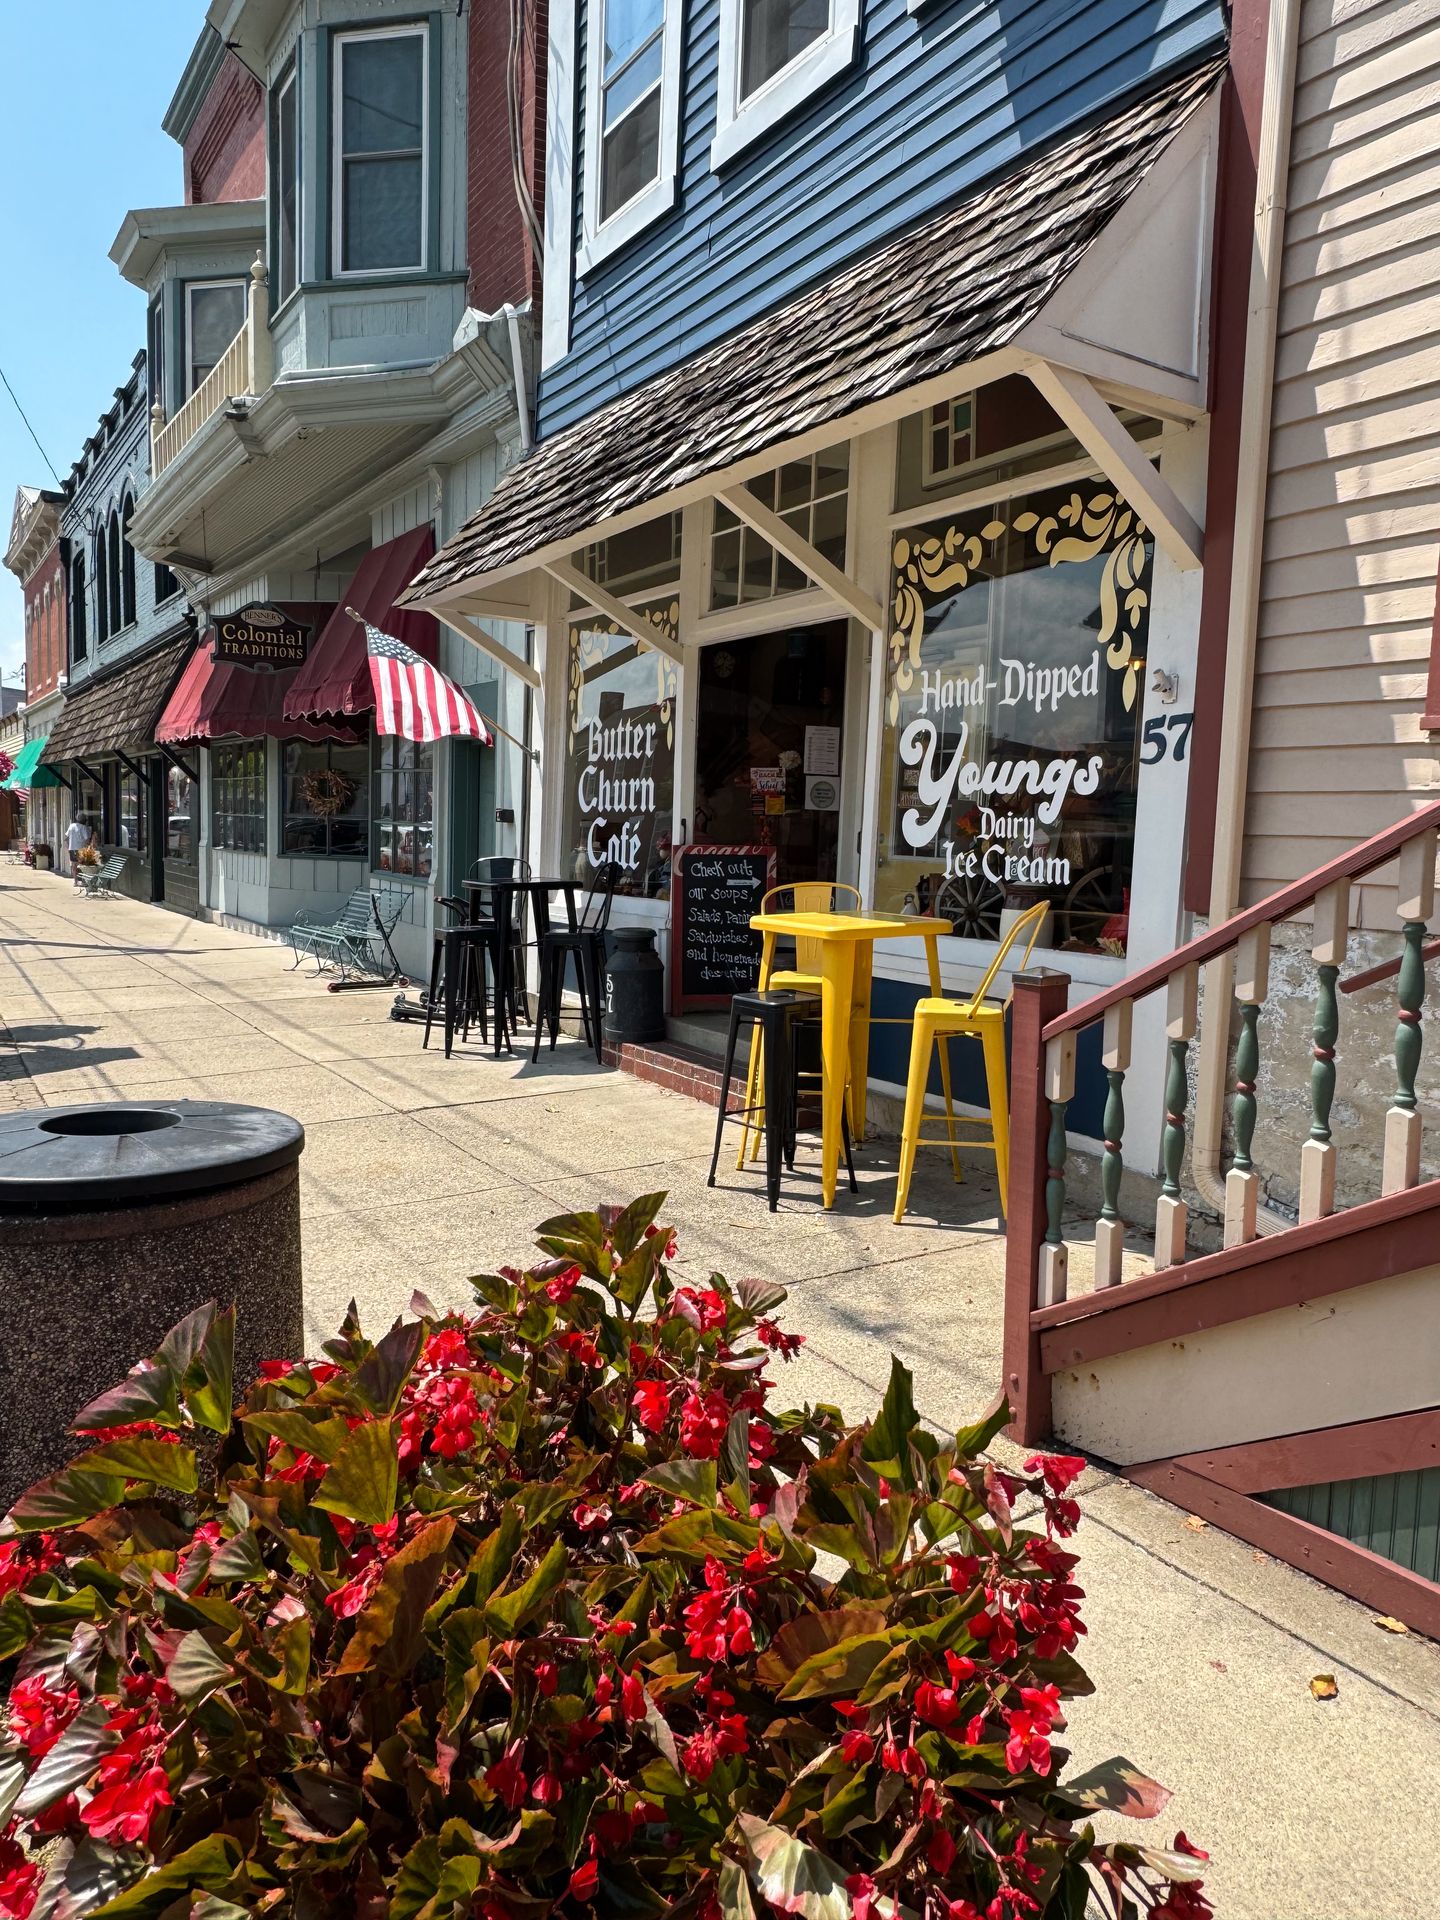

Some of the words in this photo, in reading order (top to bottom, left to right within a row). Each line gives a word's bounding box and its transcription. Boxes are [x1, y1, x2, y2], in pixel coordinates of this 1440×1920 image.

[222, 624, 304, 646] Colonial
[222, 642, 304, 659] TRADITIONS
[917, 650, 1099, 714] Hand-Dipped
[583, 716, 656, 763] Butter
[1140, 712, 1193, 766] 57
[578, 765, 656, 813] Churn
[900, 717, 1103, 848] Youngs
[587, 816, 642, 871] Café
[976, 806, 1035, 849] Dairy
[727, 859, 753, 876] out
[942, 840, 977, 880] Ice
[982, 844, 1071, 886] Cream
[688, 887, 707, 901] our
[686, 947, 707, 961] and
